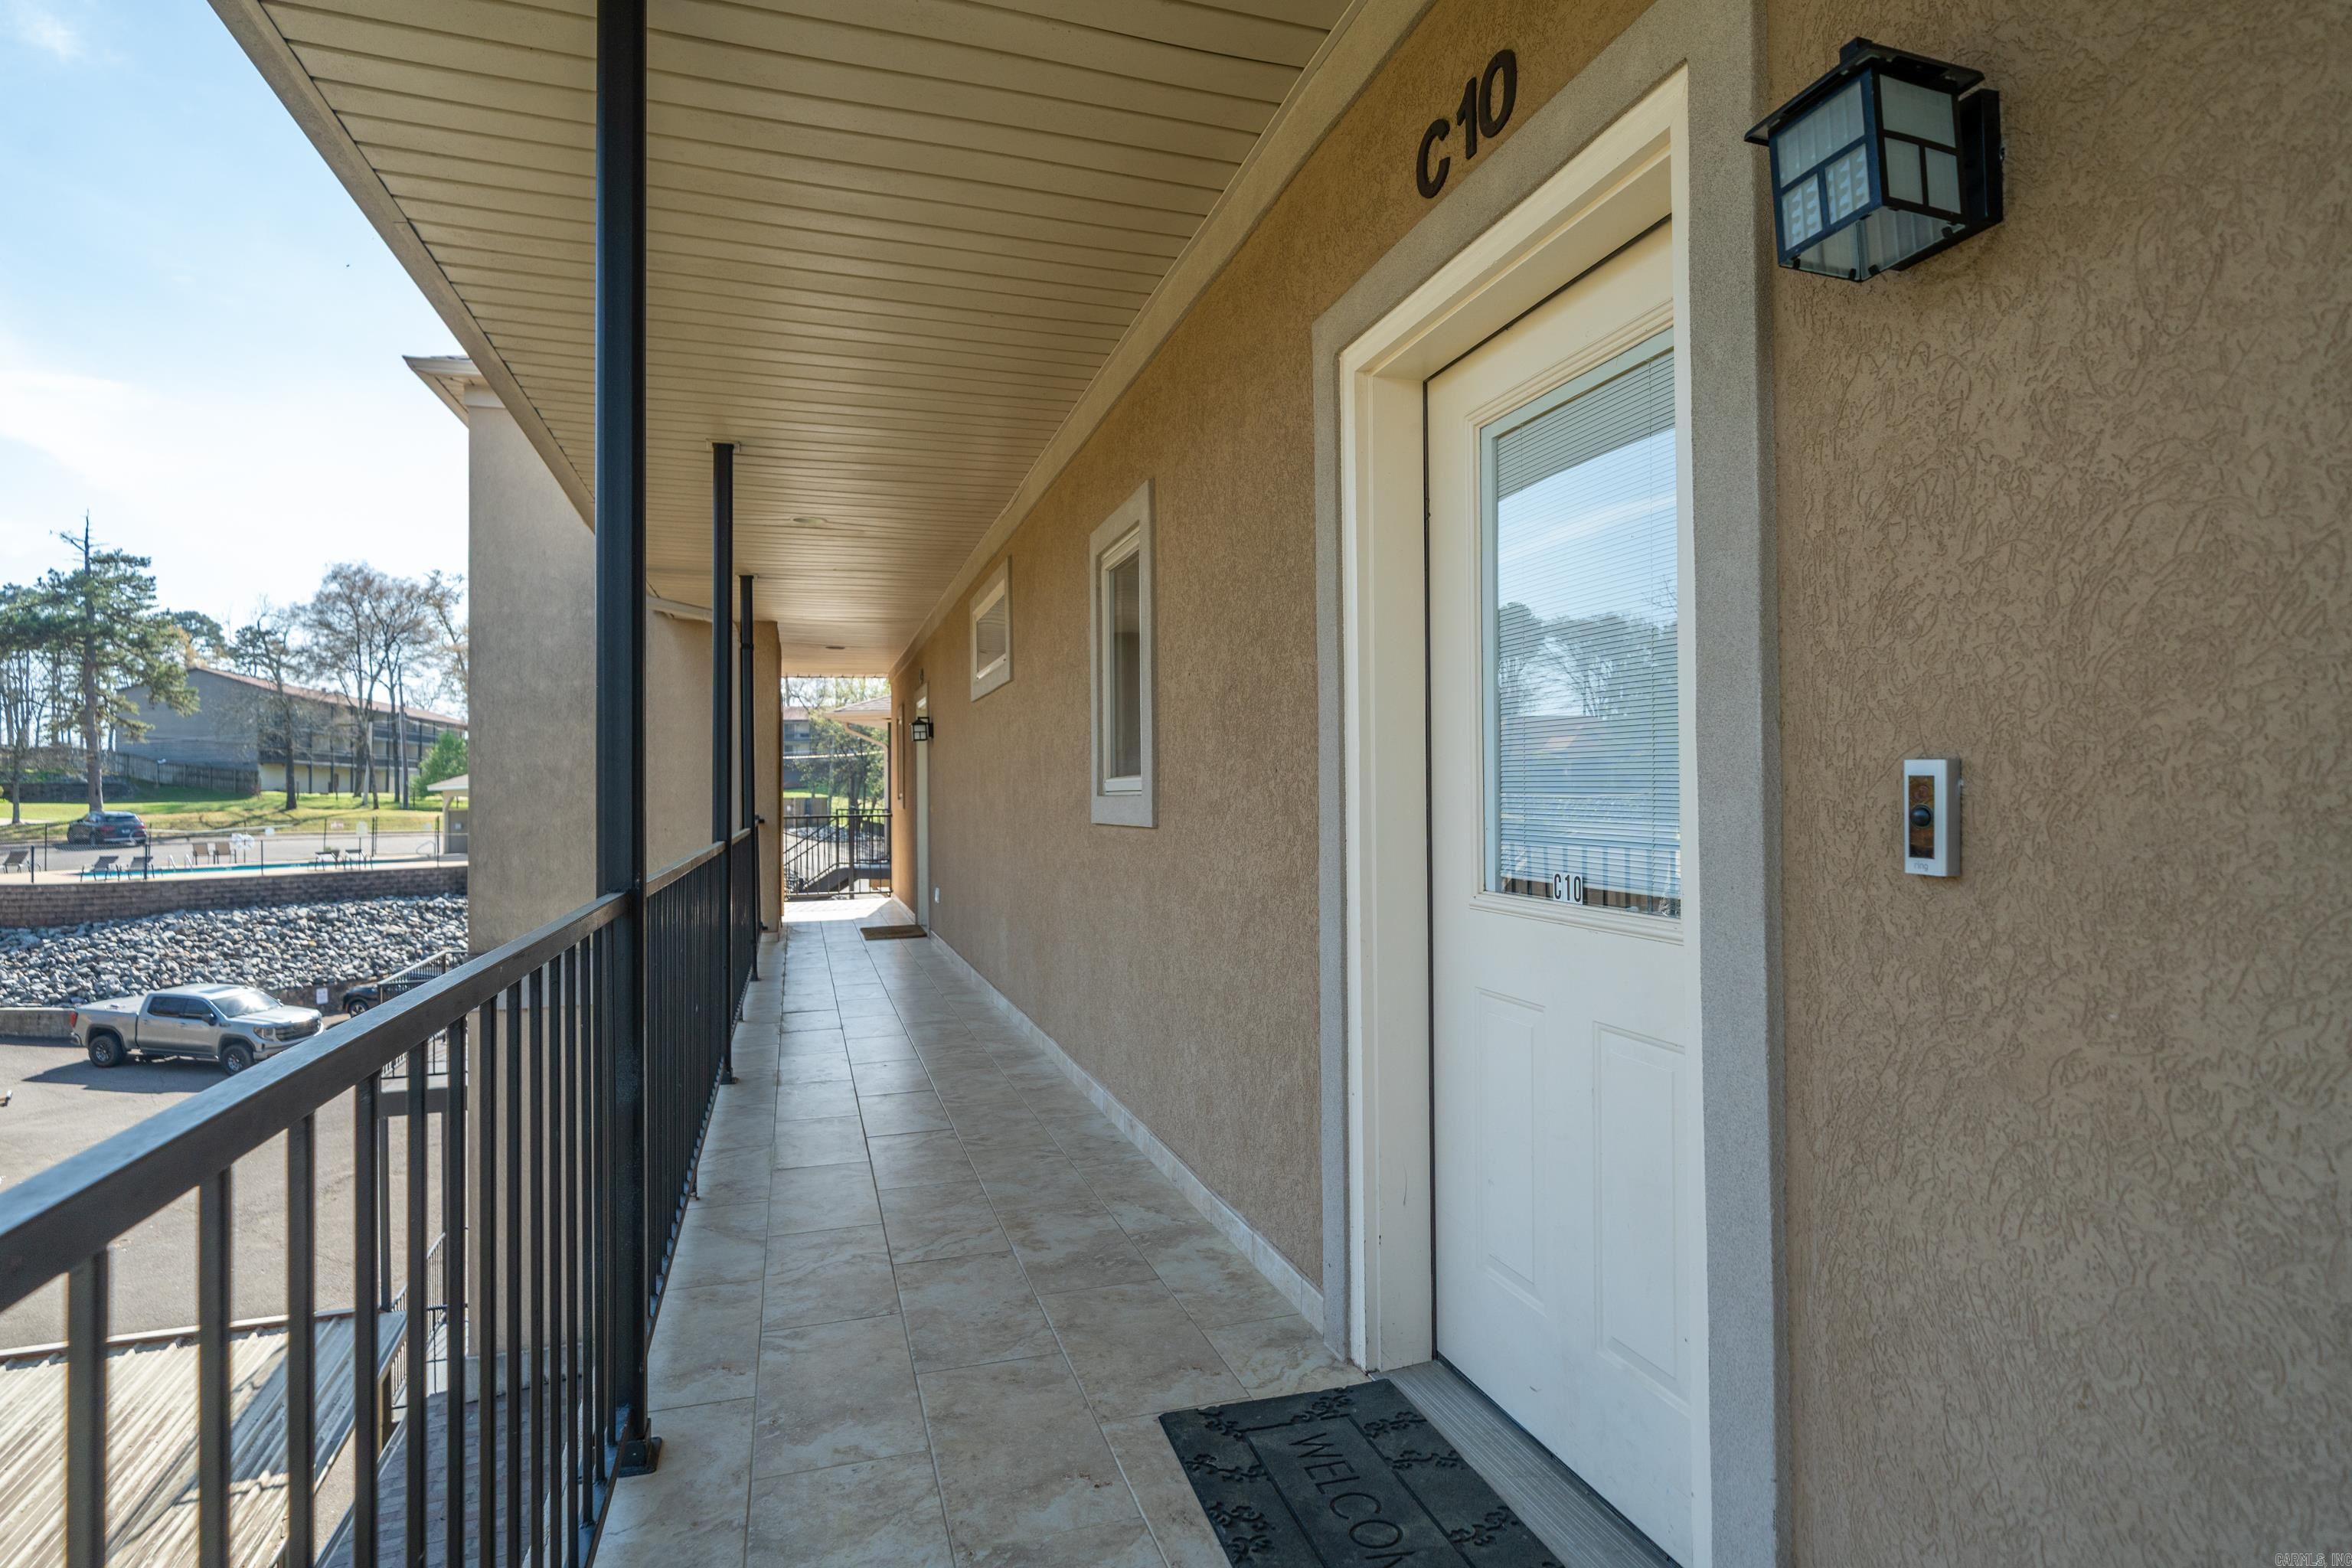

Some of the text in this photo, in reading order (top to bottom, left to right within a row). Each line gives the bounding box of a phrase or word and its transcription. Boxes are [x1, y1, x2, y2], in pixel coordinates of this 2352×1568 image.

[1416, 48, 1517, 199] C10
[1913, 861, 1929, 872] ring
[1554, 873, 1582, 903] C10
